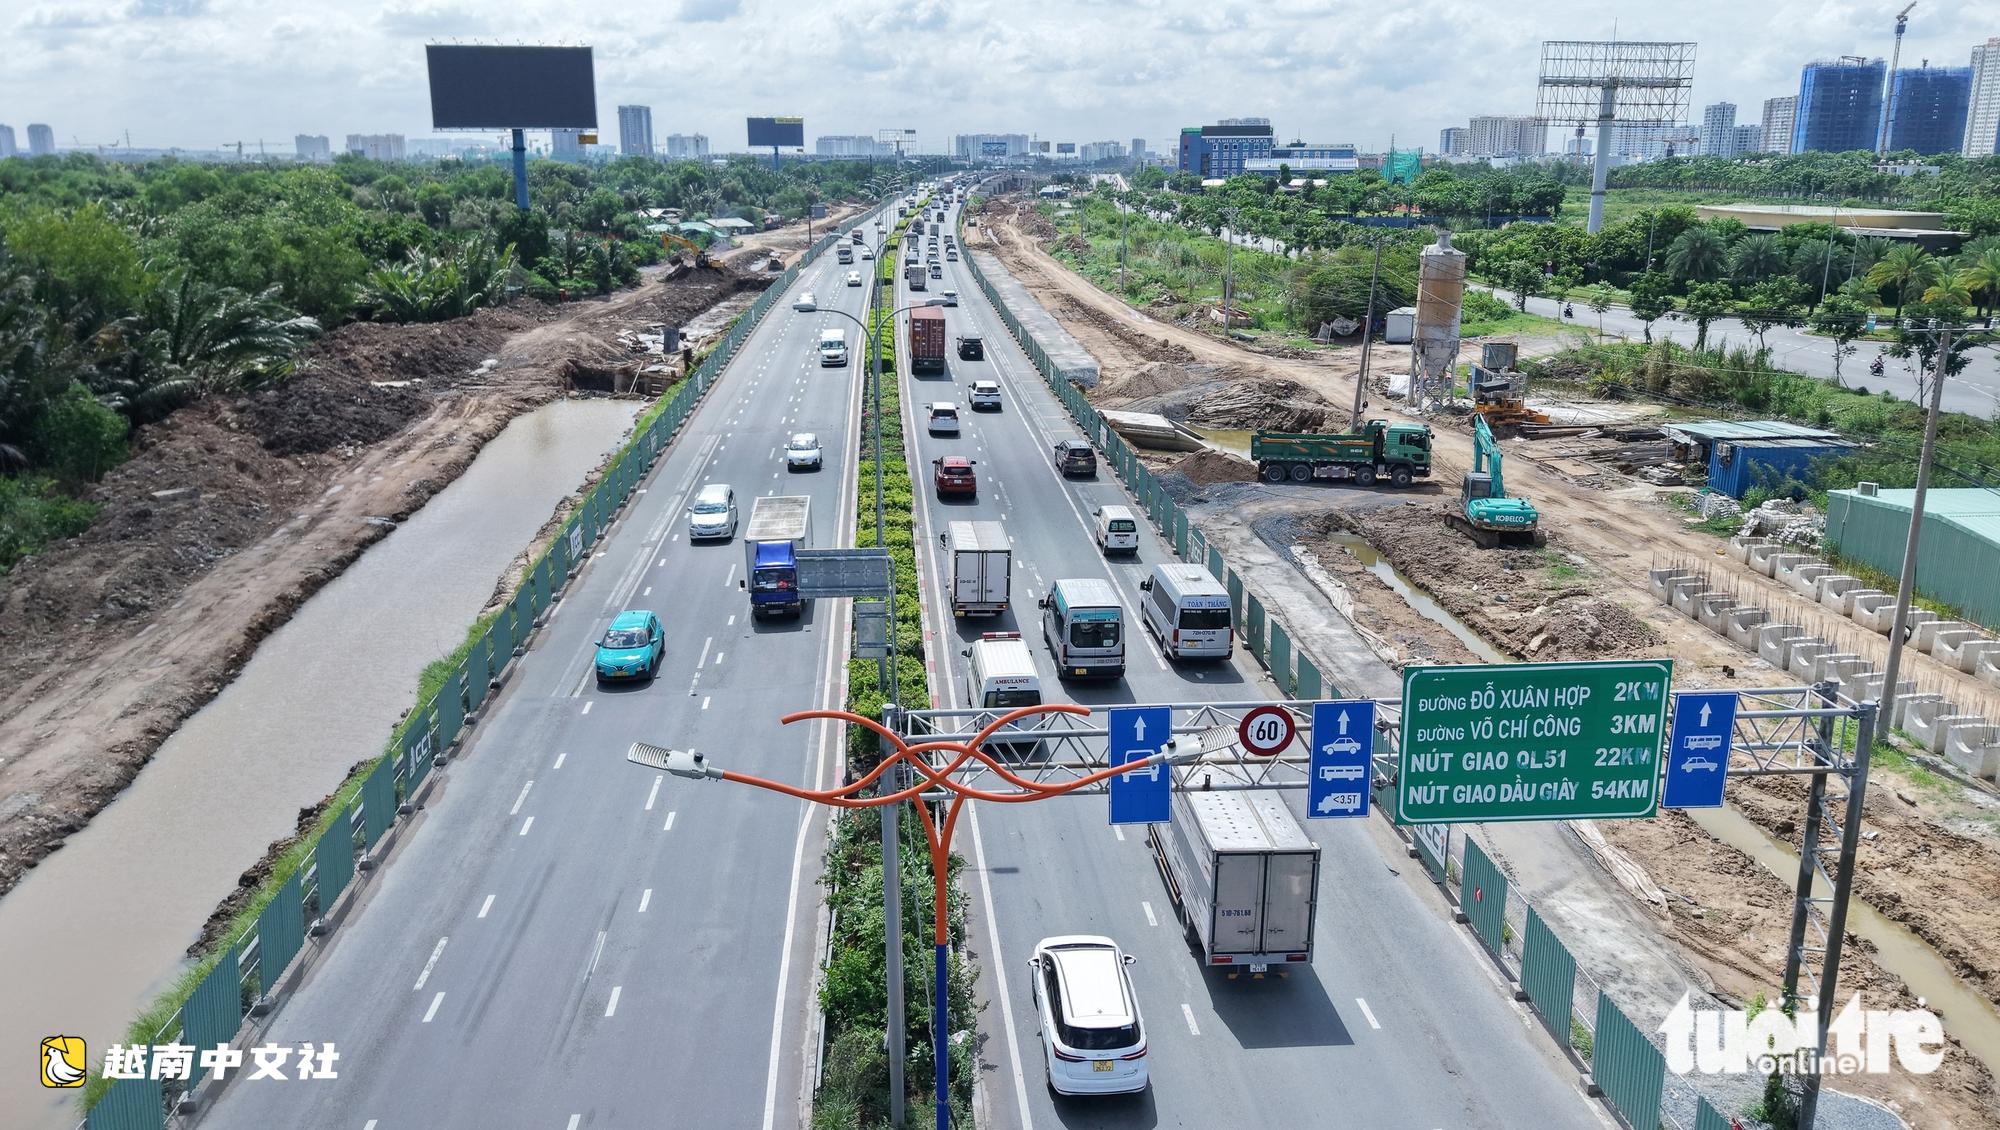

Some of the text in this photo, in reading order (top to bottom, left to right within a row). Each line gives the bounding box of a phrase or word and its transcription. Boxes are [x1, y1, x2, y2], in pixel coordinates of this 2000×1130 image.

[1495, 515, 1525, 523] KOBELCO
[1419, 681, 1660, 712] ĐƯỜNG ĐỖ XUÂN HỢP 2KM
[1256, 720, 1279, 741] 60
[1417, 713, 1656, 742] ĐƯỜNG VÕ CHÍ CÔNG 3KM
[1411, 746, 1652, 773] NÚT GIAO QL51 22KM
[1408, 774, 1649, 805] NÚT GIAO DẦU GIÂY 54KM
